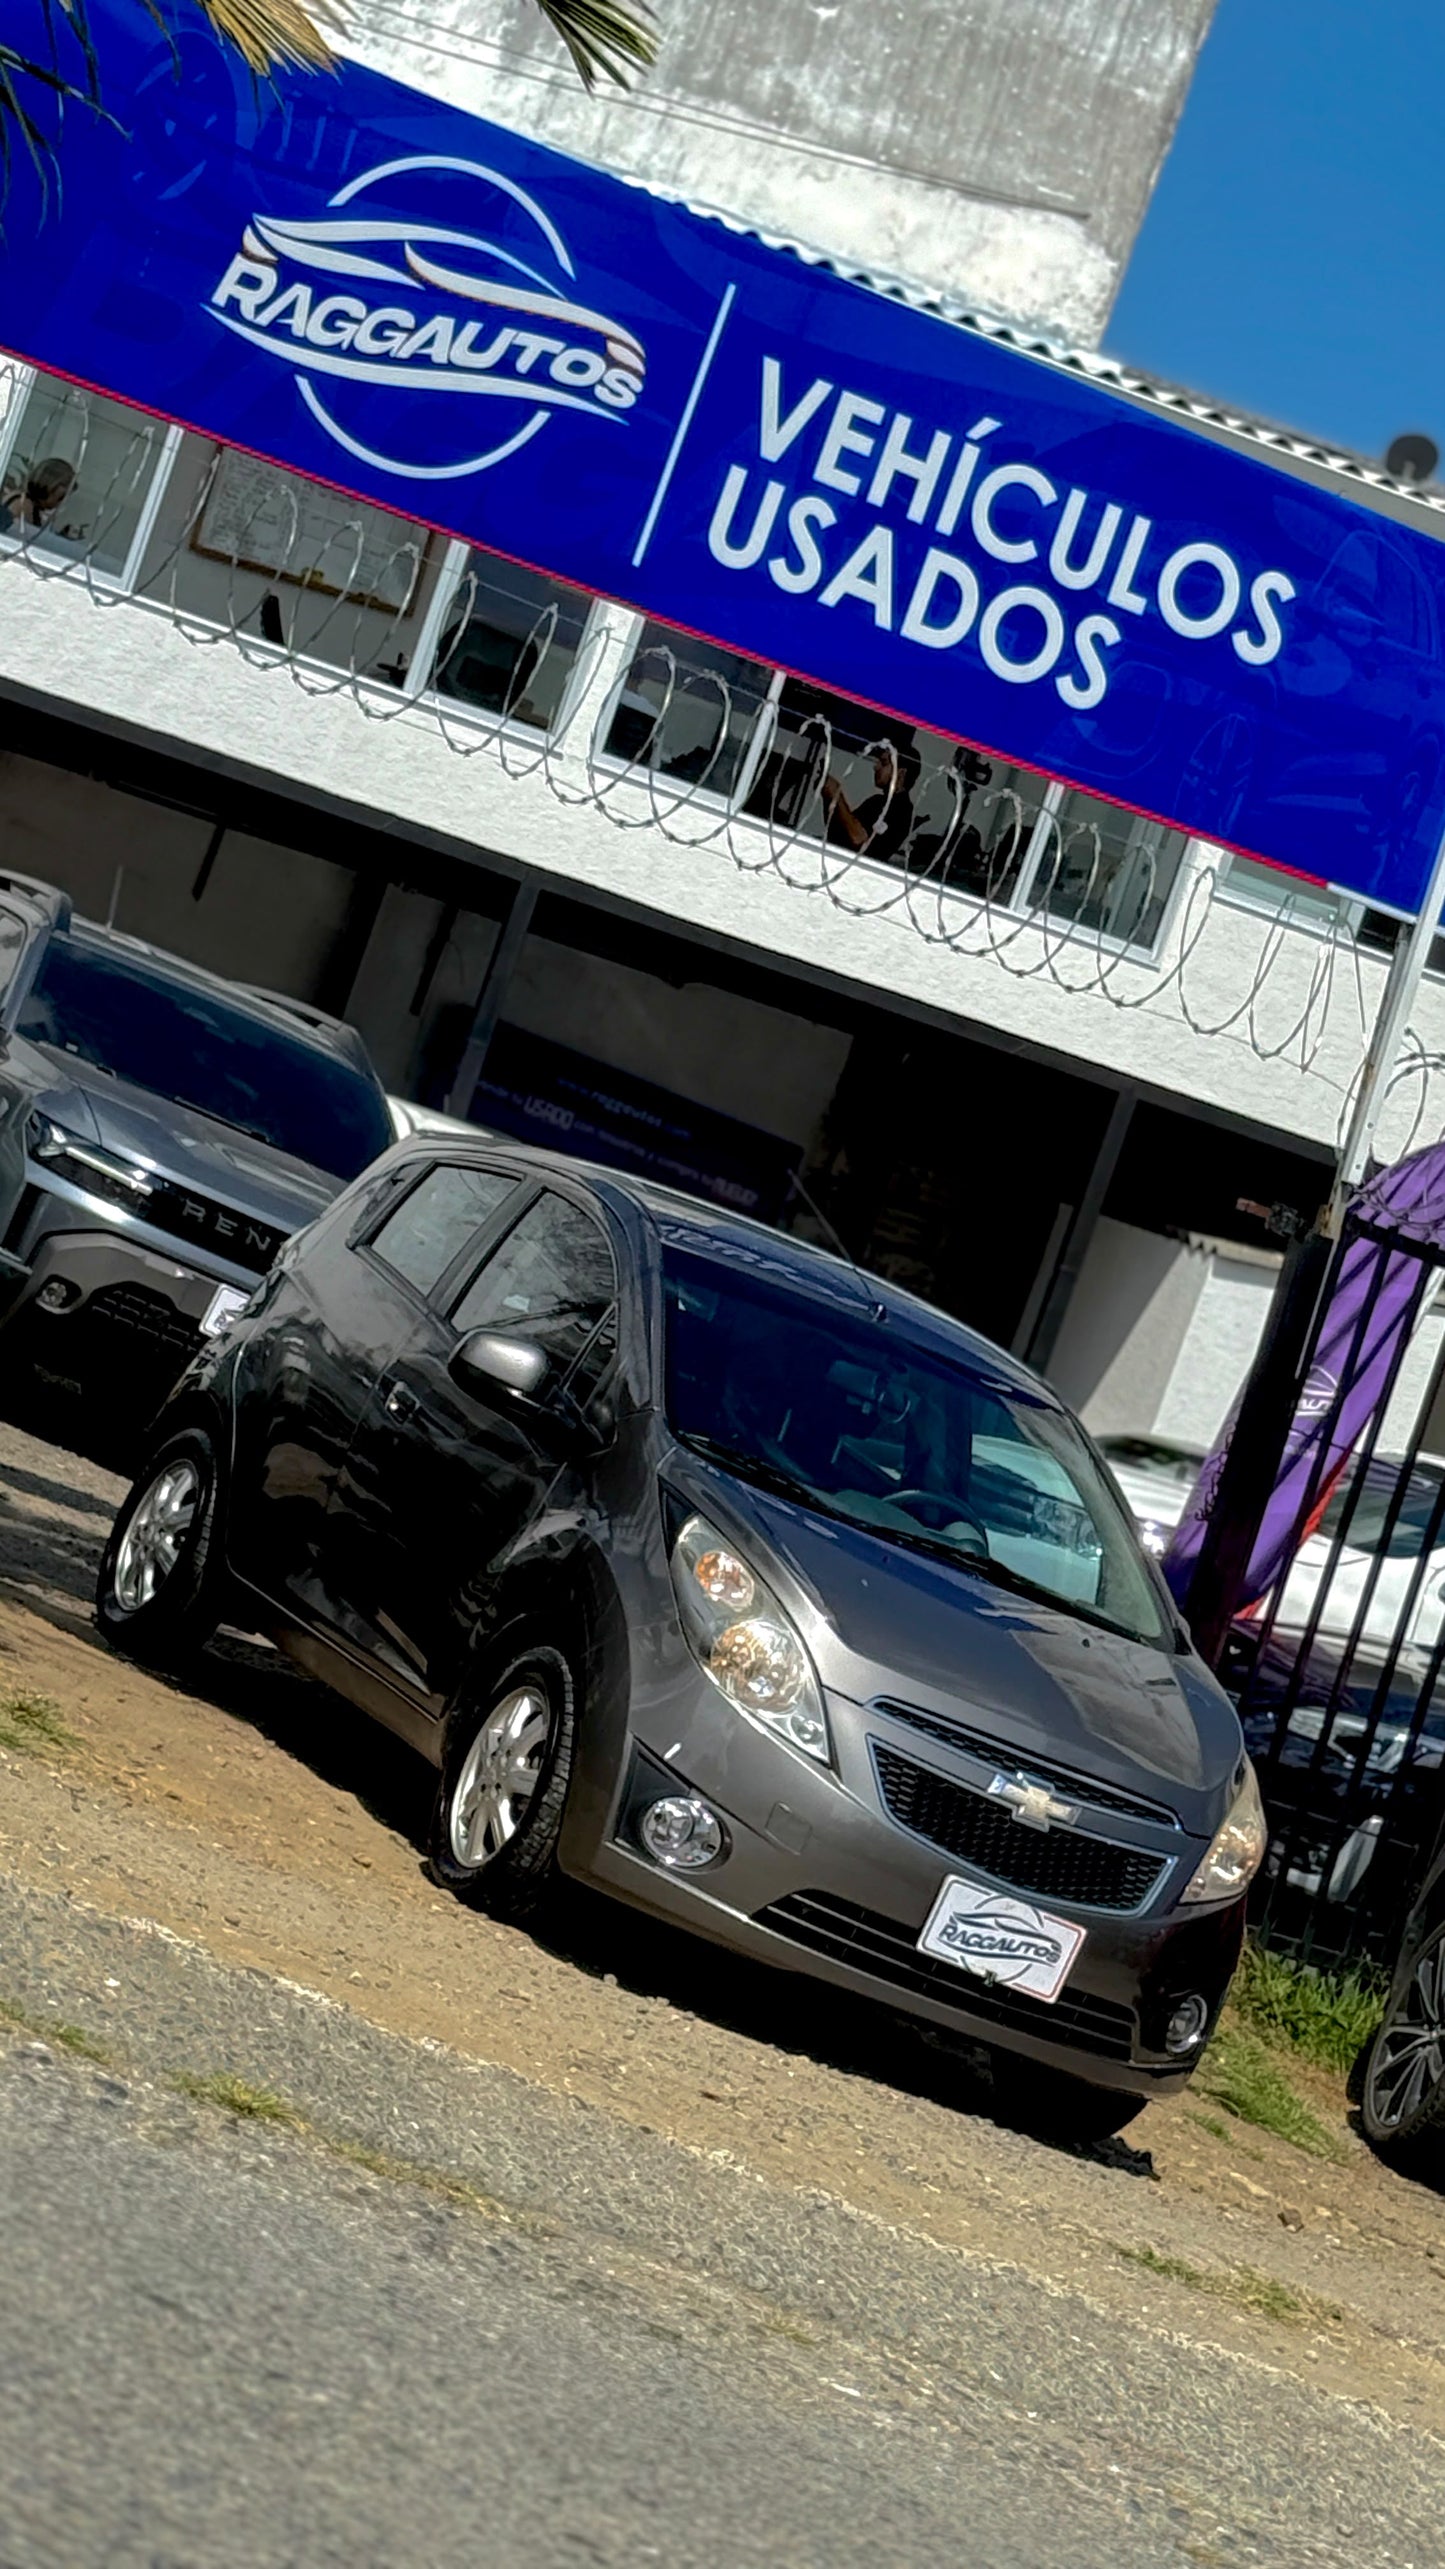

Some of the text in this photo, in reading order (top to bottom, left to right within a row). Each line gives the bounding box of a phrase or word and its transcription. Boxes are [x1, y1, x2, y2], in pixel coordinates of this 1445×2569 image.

[211, 252, 644, 411] RAGGAUTOS
[708, 465, 1122, 710] USADOS
[760, 356, 1297, 666] VEHÍCULOS
[183, 1200, 271, 1251] REN
[939, 1923, 1062, 1964] RAGGAUTOS
